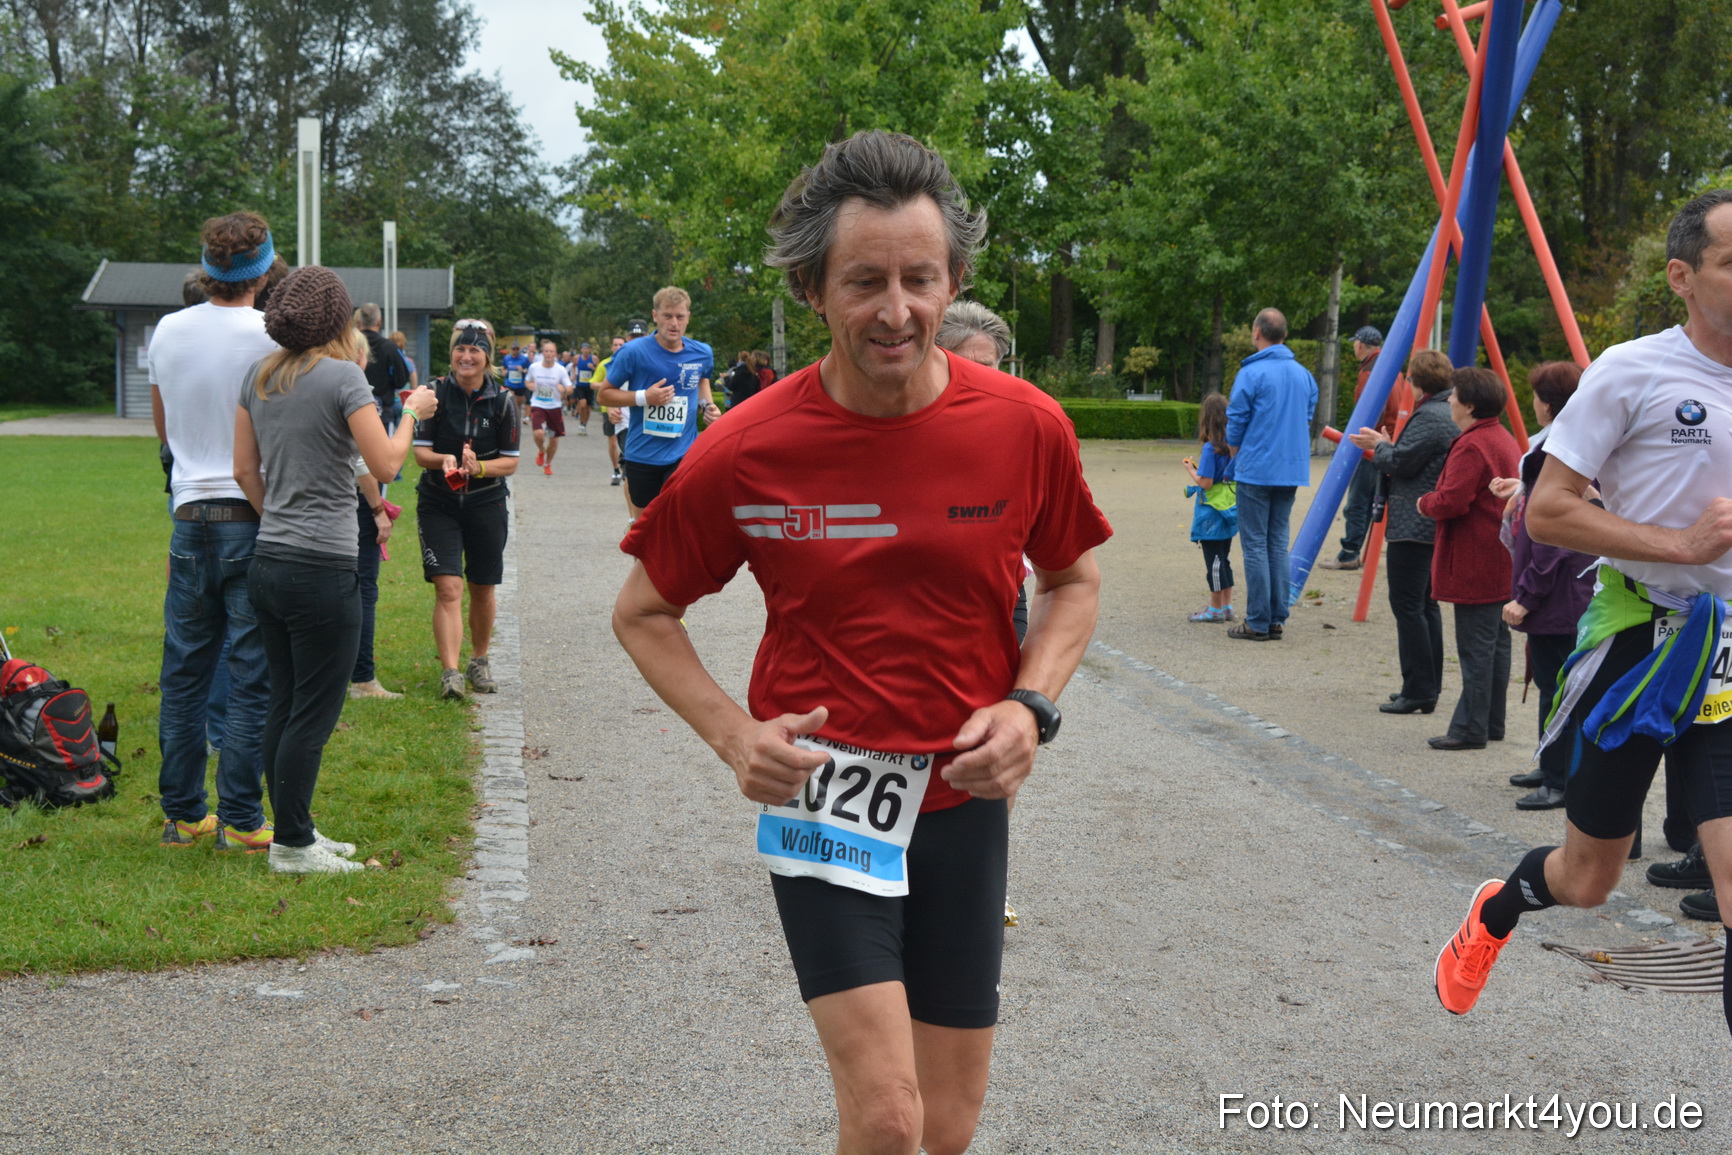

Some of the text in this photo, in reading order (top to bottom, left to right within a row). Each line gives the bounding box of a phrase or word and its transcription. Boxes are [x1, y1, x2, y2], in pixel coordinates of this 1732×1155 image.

[648, 405, 685, 422] 2084
[1671, 428, 1712, 438] PARTL
[192, 507, 232, 521] PMA
[947, 505, 989, 519] swn
[783, 755, 908, 833] 026
[781, 826, 872, 873] Wolfgang
